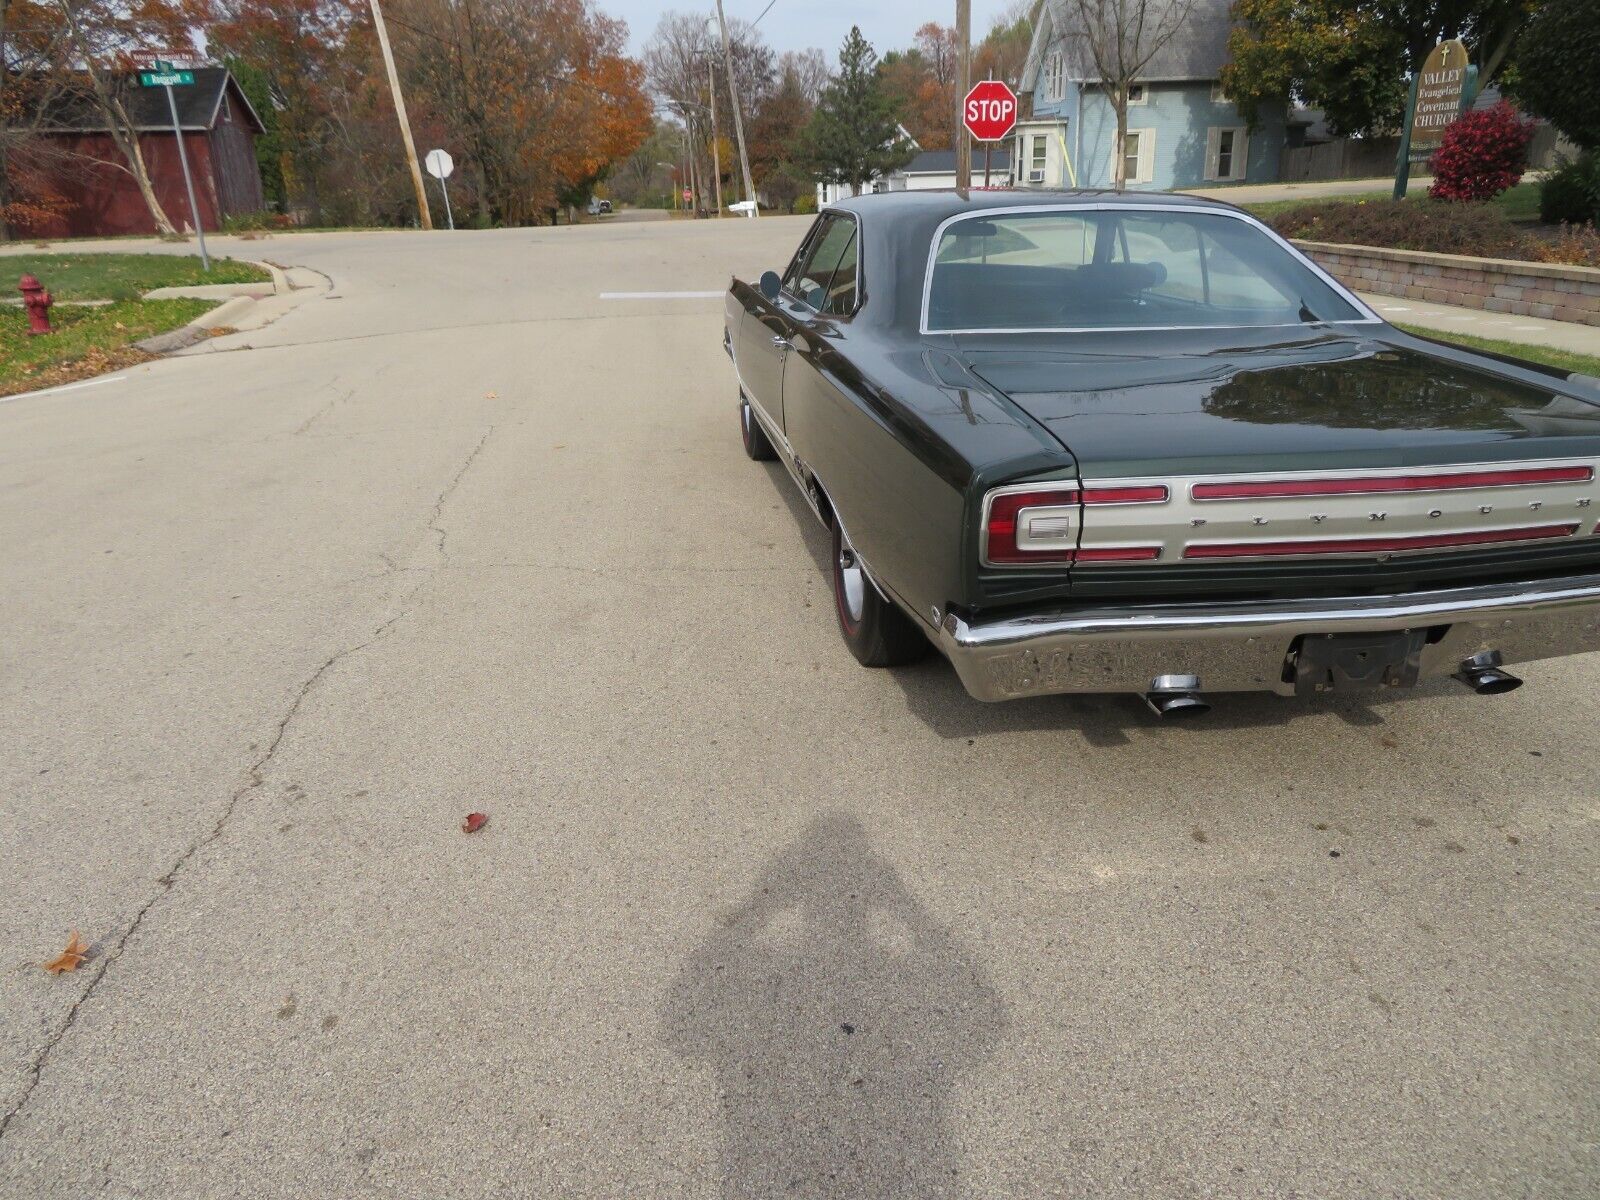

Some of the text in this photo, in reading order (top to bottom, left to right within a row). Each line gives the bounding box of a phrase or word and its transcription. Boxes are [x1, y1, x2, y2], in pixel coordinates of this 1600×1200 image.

[1425, 69, 1461, 84] VALLEY
[1419, 85, 1462, 98] Evangelical
[967, 99, 1013, 122] STOP
[1417, 100, 1460, 112] Covenant
[1190, 497, 1591, 527] PLYMOUTH
